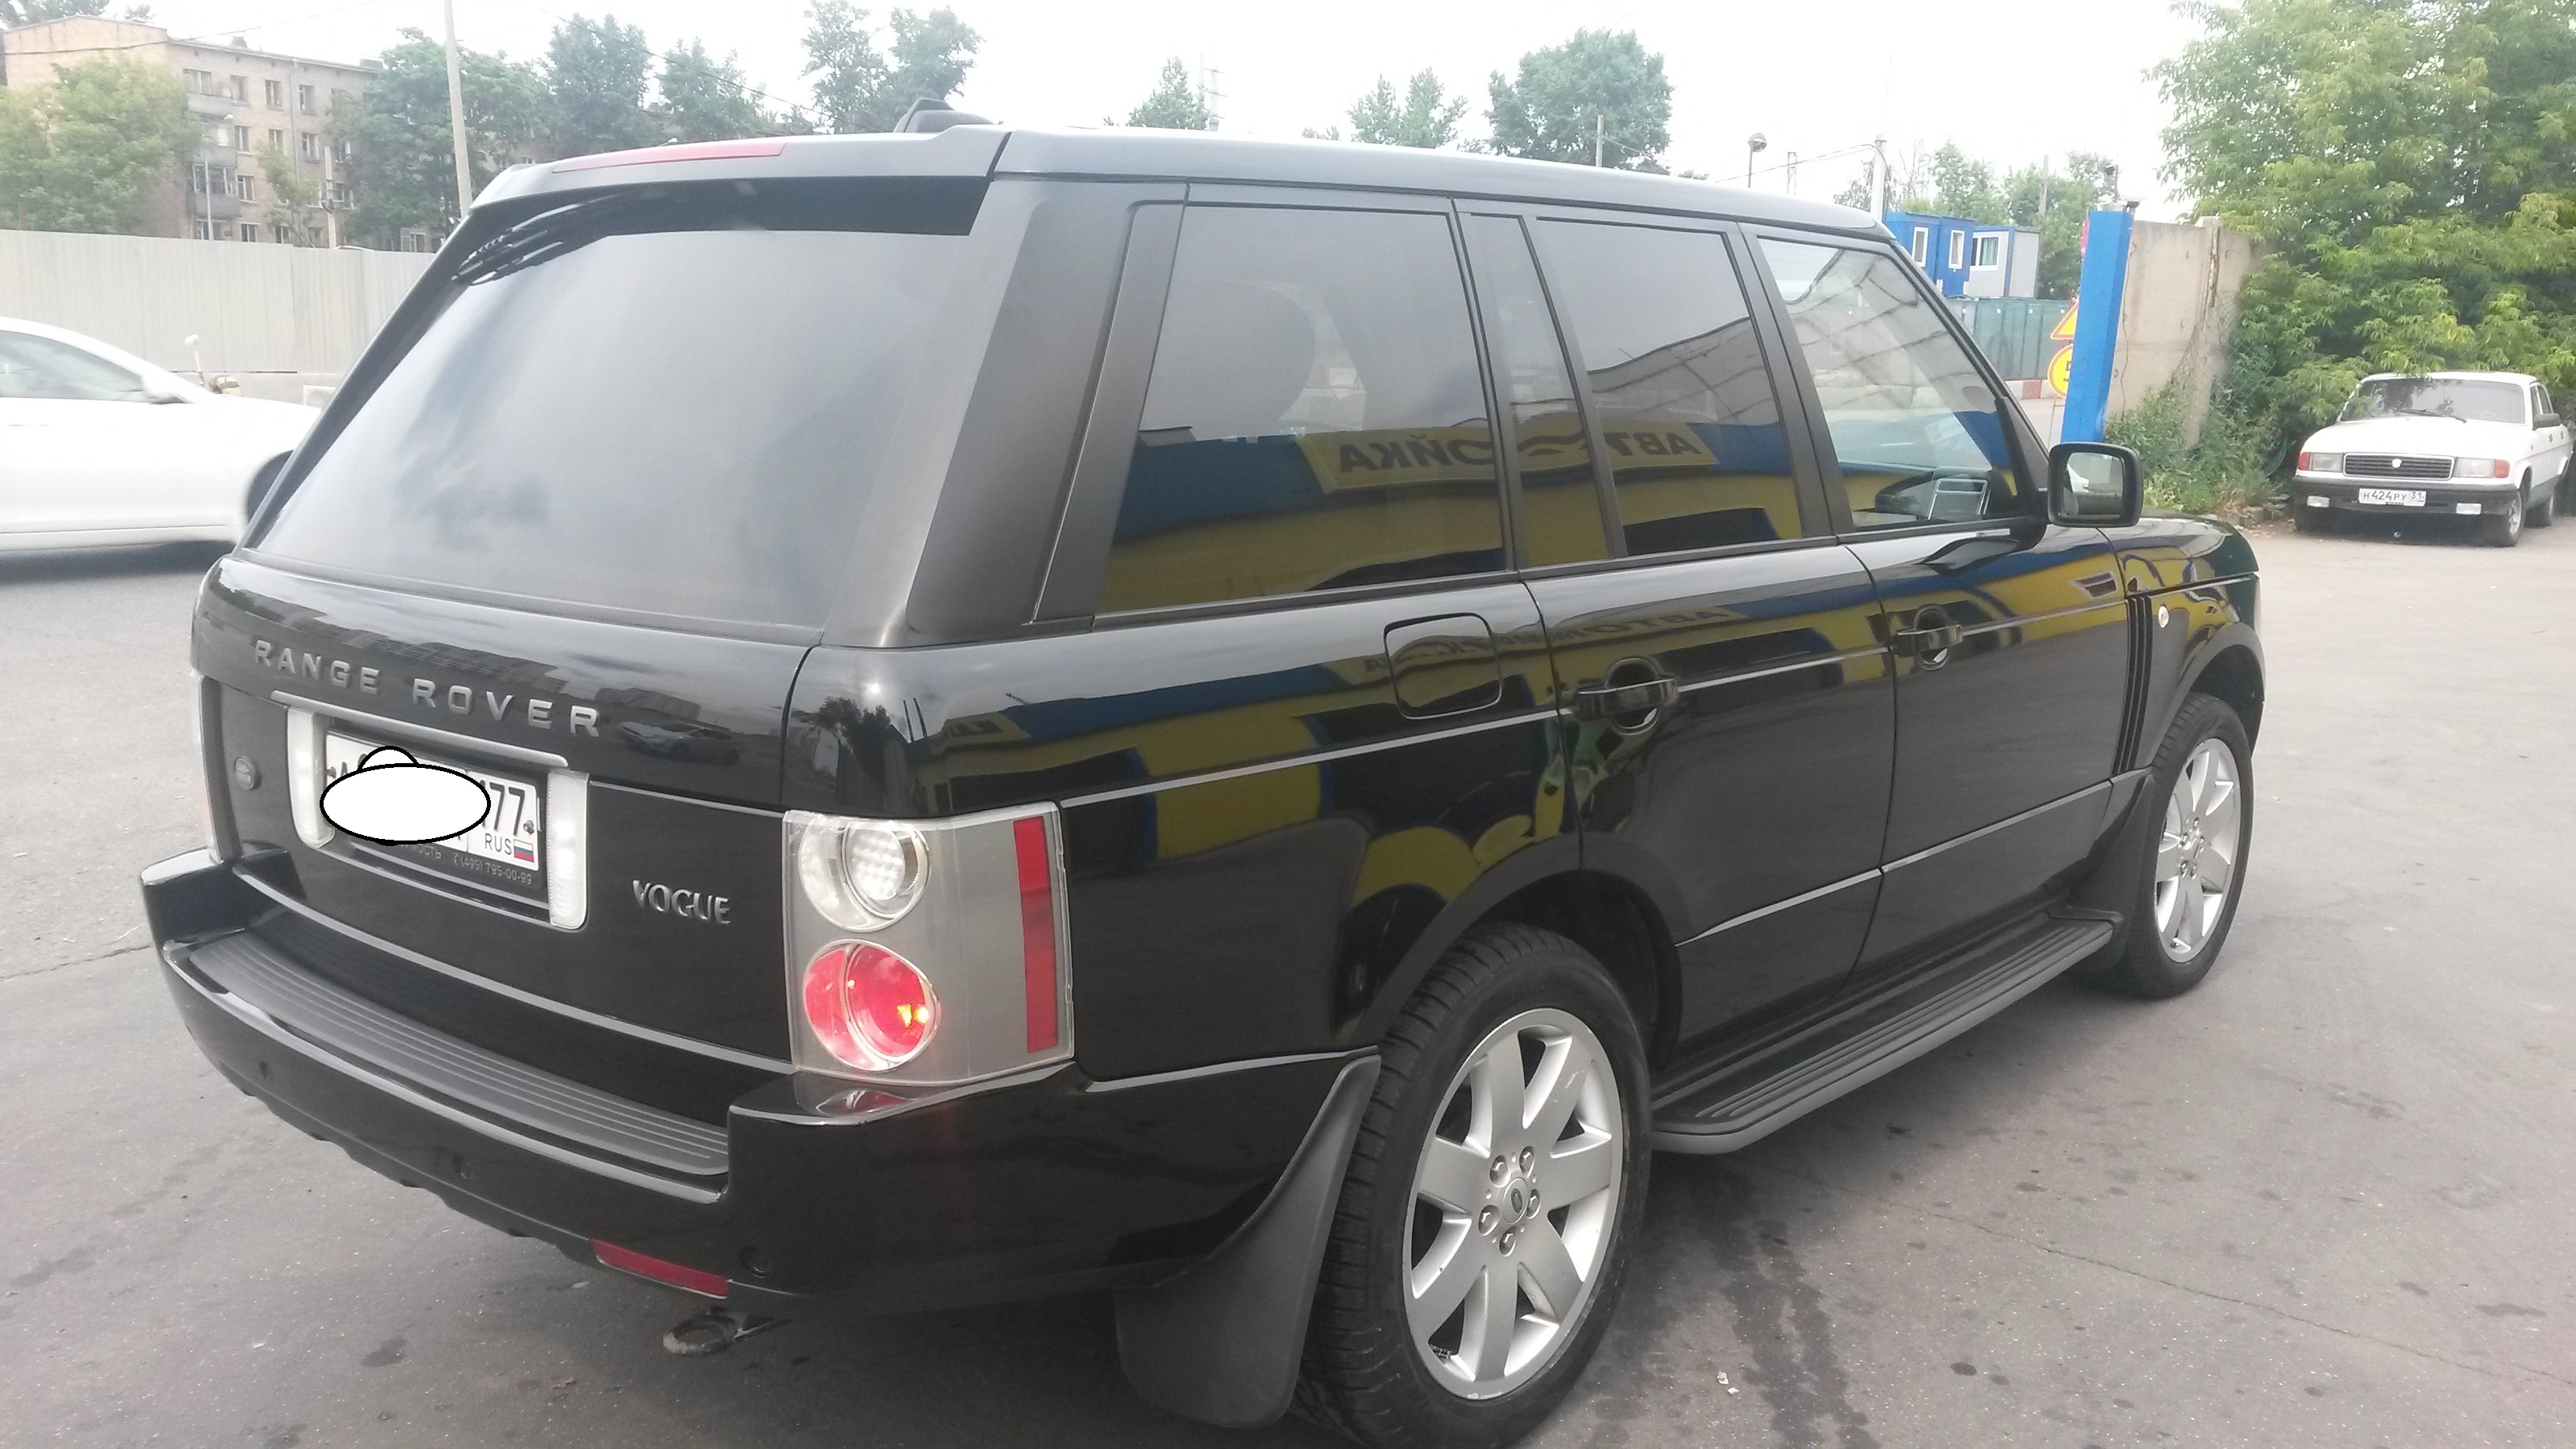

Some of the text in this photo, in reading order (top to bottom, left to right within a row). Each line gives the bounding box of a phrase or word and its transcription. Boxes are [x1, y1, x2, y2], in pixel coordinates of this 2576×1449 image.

[254, 639, 600, 737] RANGE ROVER
[485, 833, 512, 856] RUS
[633, 879, 731, 925] VOGUE
